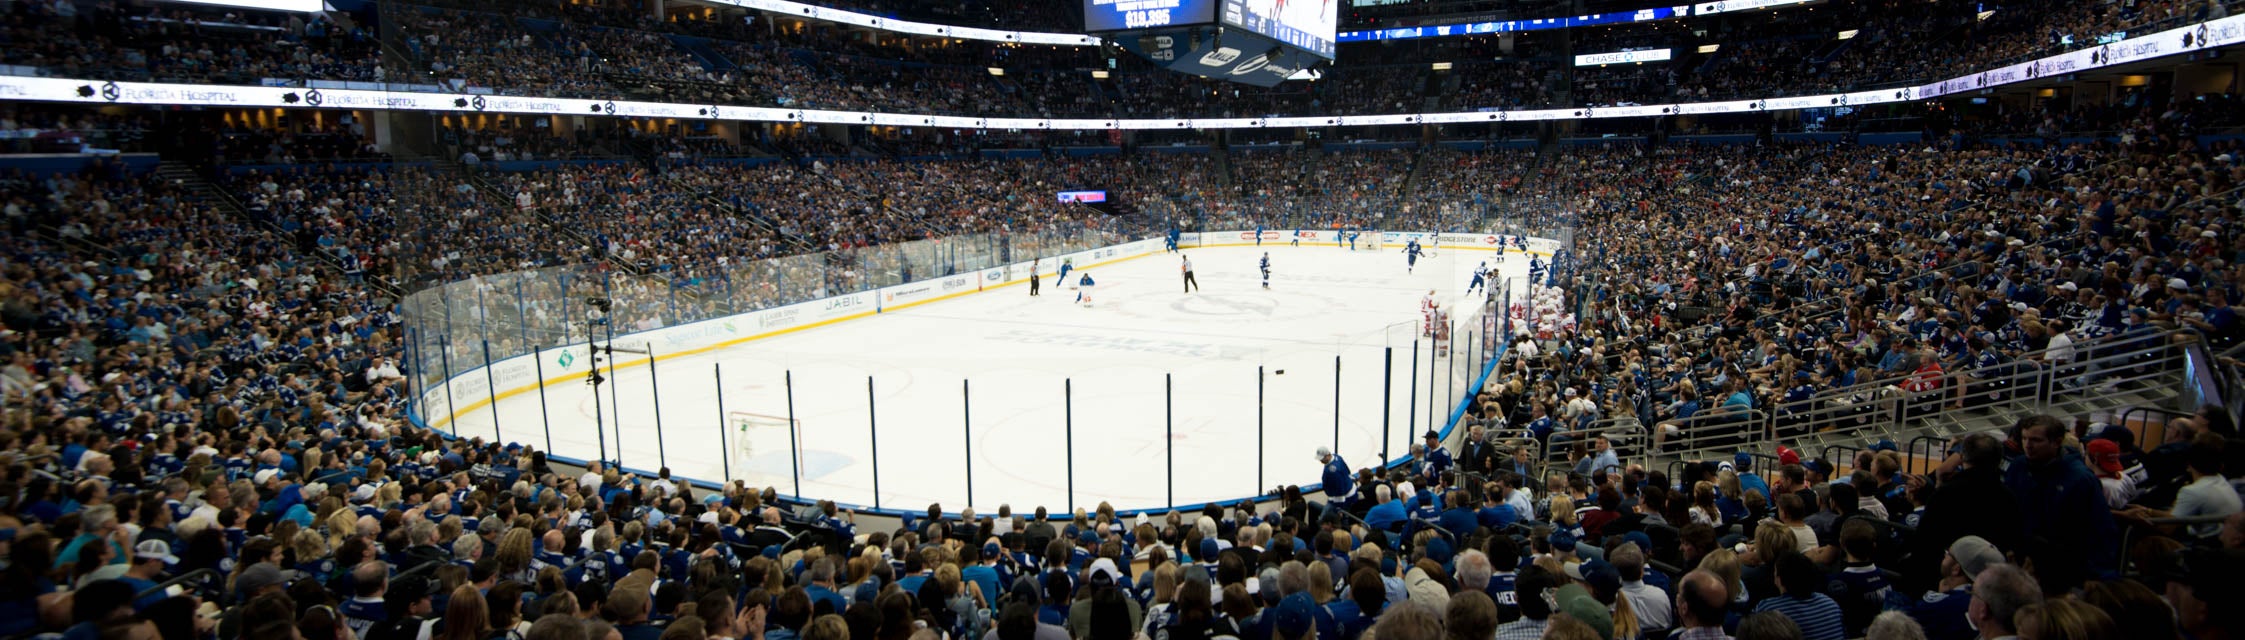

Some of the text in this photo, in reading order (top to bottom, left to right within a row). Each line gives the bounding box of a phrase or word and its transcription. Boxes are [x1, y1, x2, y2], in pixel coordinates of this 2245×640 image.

[1585, 51, 1659, 64] CHASE CLUB
[180, 90, 238, 102] HOSPITAL
[372, 96, 418, 107] HOSPITAL
[1438, 235, 1476, 243] RIDGESTONE
[826, 295, 863, 311] JABIL
